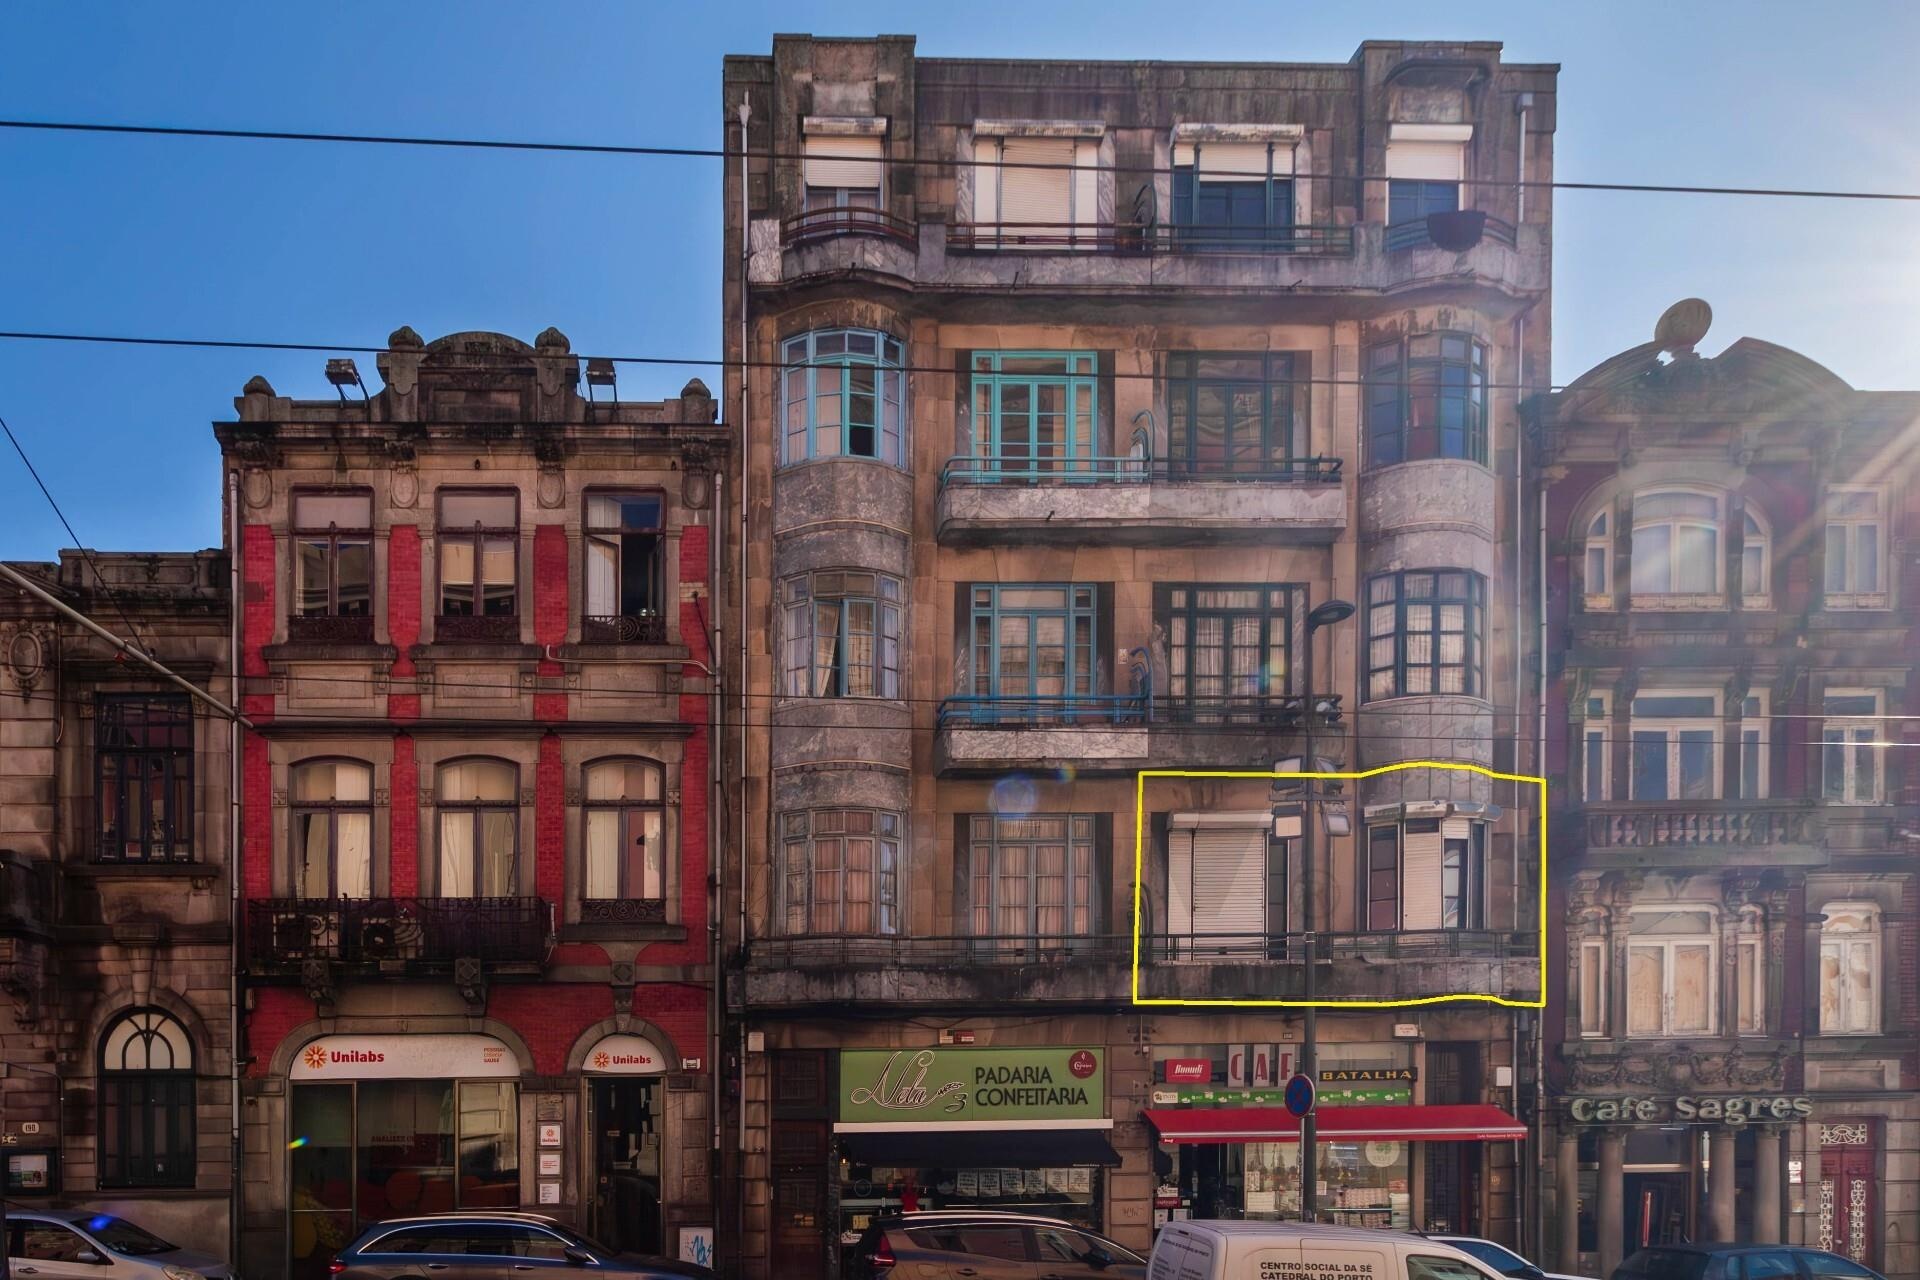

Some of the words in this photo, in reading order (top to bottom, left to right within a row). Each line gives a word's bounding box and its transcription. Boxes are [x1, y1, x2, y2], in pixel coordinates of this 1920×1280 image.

[331, 1050, 385, 1063] Unilabs
[612, 1054, 652, 1064] Unilabs
[1230, 1053, 1293, 1080] CAF
[975, 1066, 1053, 1084] PADARIA
[1322, 1070, 1412, 1080] BATALHA
[945, 1092, 968, 1112] 3
[975, 1087, 1089, 1106] CONFEITARIA
[1571, 1096, 1659, 1122] Café
[1675, 1095, 1813, 1126] Sagres
[1260, 1262, 1302, 1270] CENTRO
[1304, 1263, 1341, 1272] SOCIAL
[1344, 1264, 1357, 1272] DA
[1260, 1271, 1317, 1280] CATEDRAL
